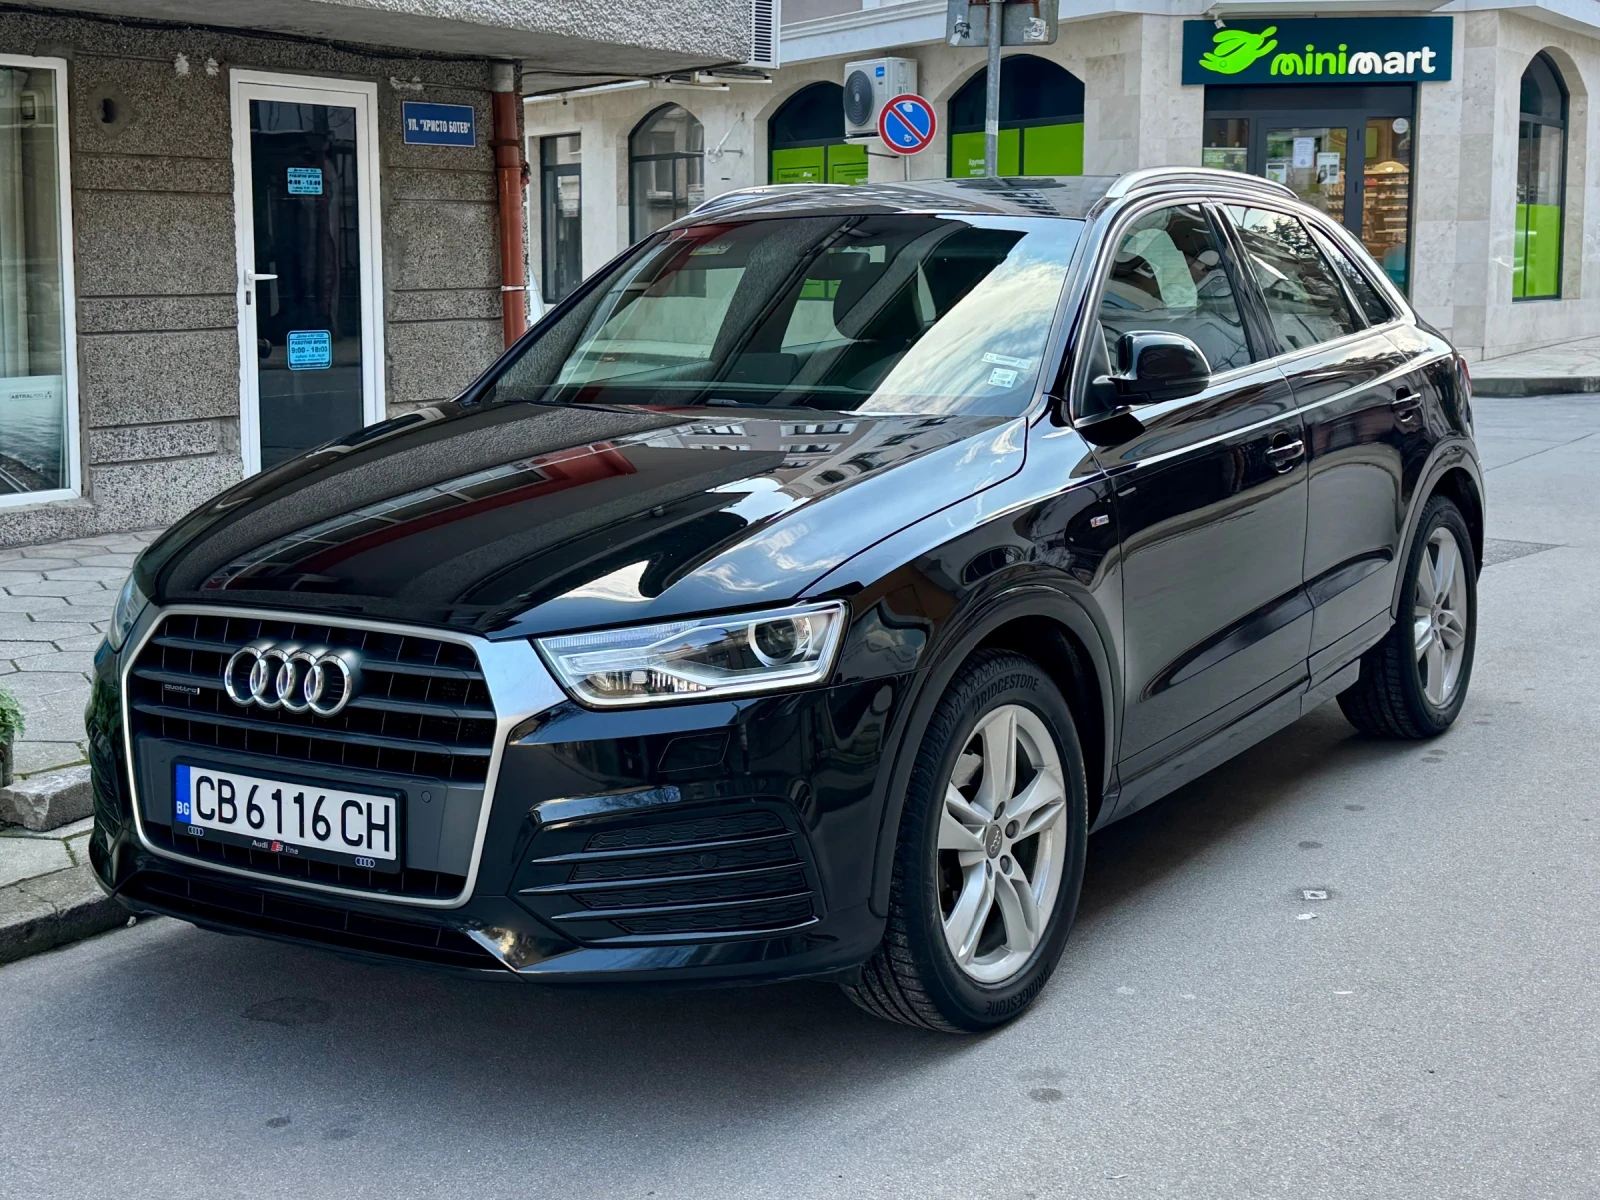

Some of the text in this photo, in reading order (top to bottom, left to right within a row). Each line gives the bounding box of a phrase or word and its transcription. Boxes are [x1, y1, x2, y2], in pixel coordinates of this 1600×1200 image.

[1270, 43, 1436, 75] minimart
[407, 118, 419, 131] УЛ.
[164, 684, 197, 693] quattro
[176, 800, 190, 816] BG
[196, 776, 390, 853] CB 6116 CH
[252, 839, 269, 849] Audi
[285, 845, 299, 855] line
